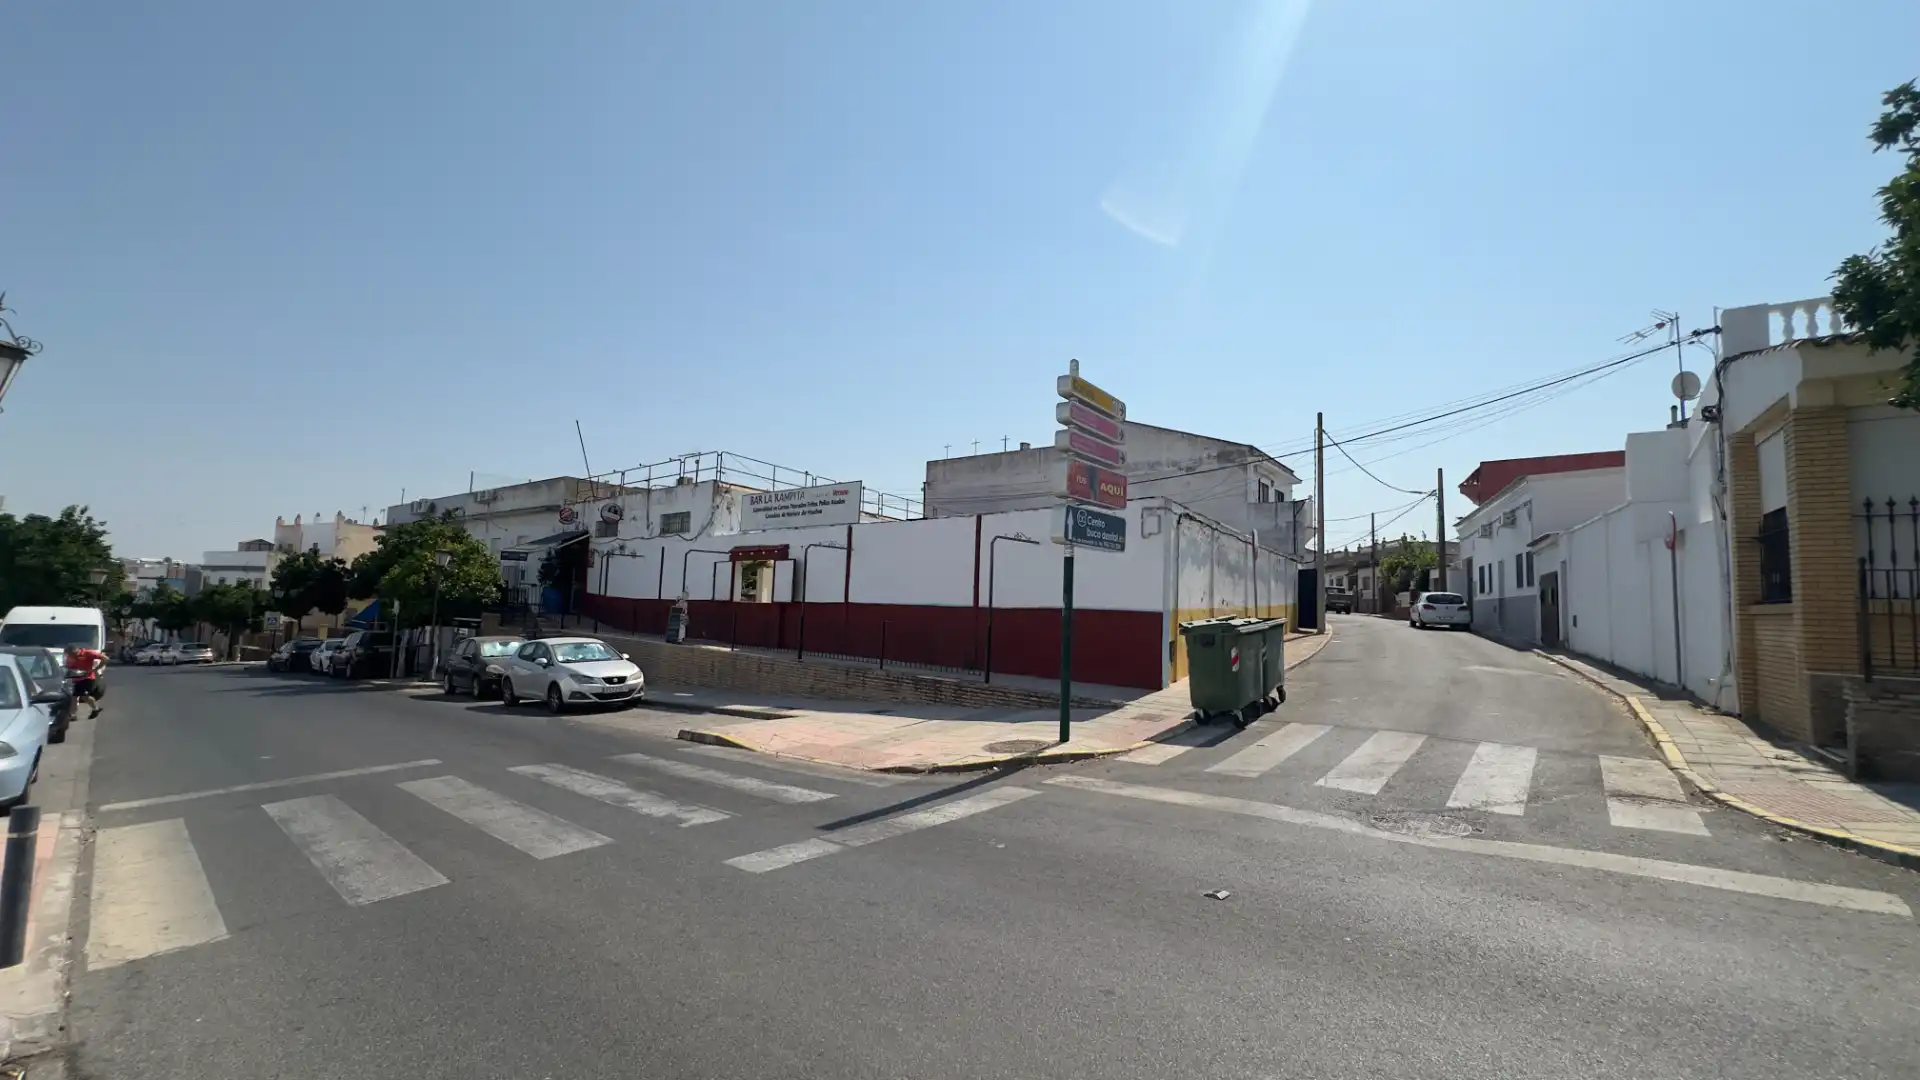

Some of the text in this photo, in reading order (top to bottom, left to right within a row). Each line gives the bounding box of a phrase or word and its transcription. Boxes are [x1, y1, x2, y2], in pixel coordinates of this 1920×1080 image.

[750, 495, 763, 505] BAR
[764, 494, 773, 504] LA
[774, 491, 805, 502] RAMPITA
[1087, 516, 1106, 529] Centro
[1086, 527, 1102, 539] buco
